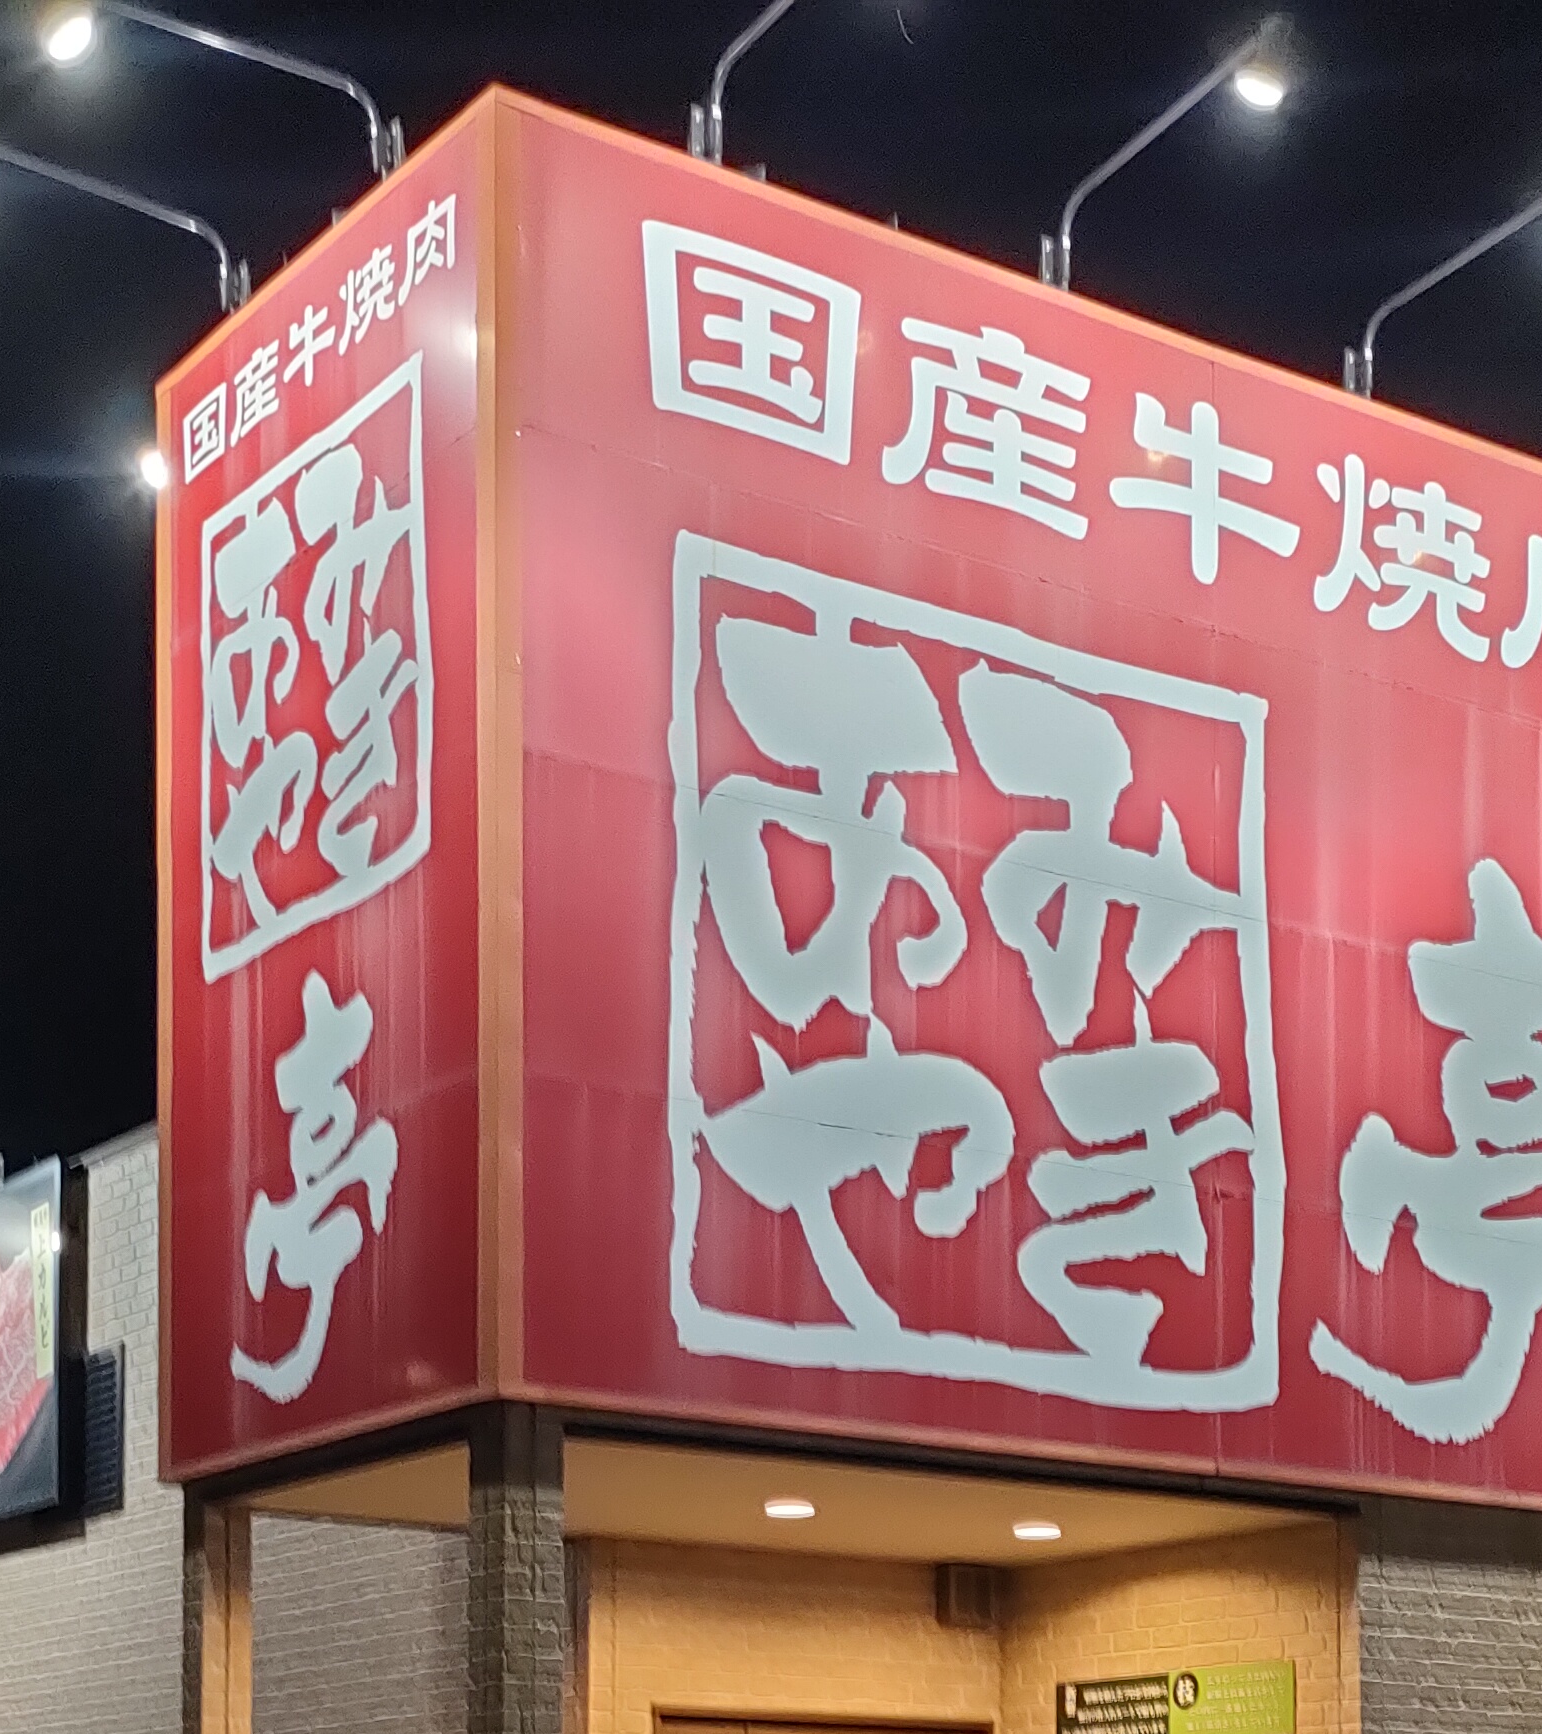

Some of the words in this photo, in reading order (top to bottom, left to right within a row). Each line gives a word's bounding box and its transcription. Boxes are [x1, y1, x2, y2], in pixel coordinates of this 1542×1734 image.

[182, 194, 458, 488] 国産牛焼肉
